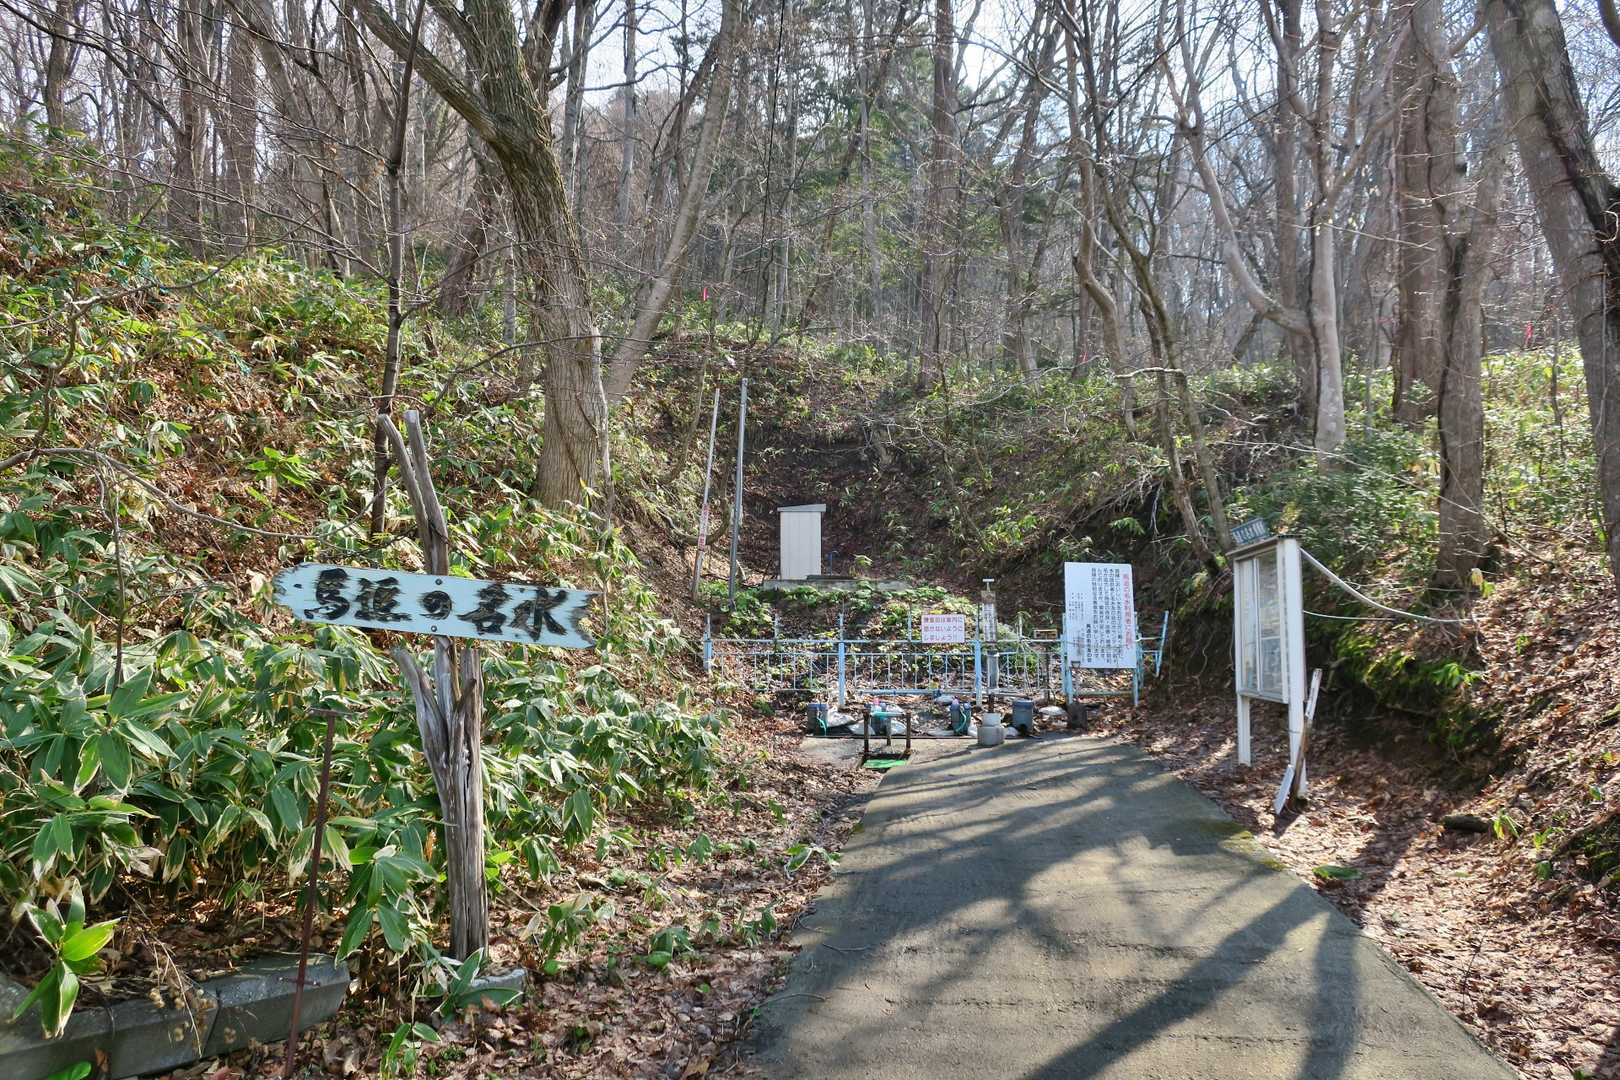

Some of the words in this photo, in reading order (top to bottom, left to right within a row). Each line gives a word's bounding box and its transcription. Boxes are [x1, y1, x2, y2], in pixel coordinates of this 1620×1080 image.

[304, 568, 569, 641] 馬追の名水
